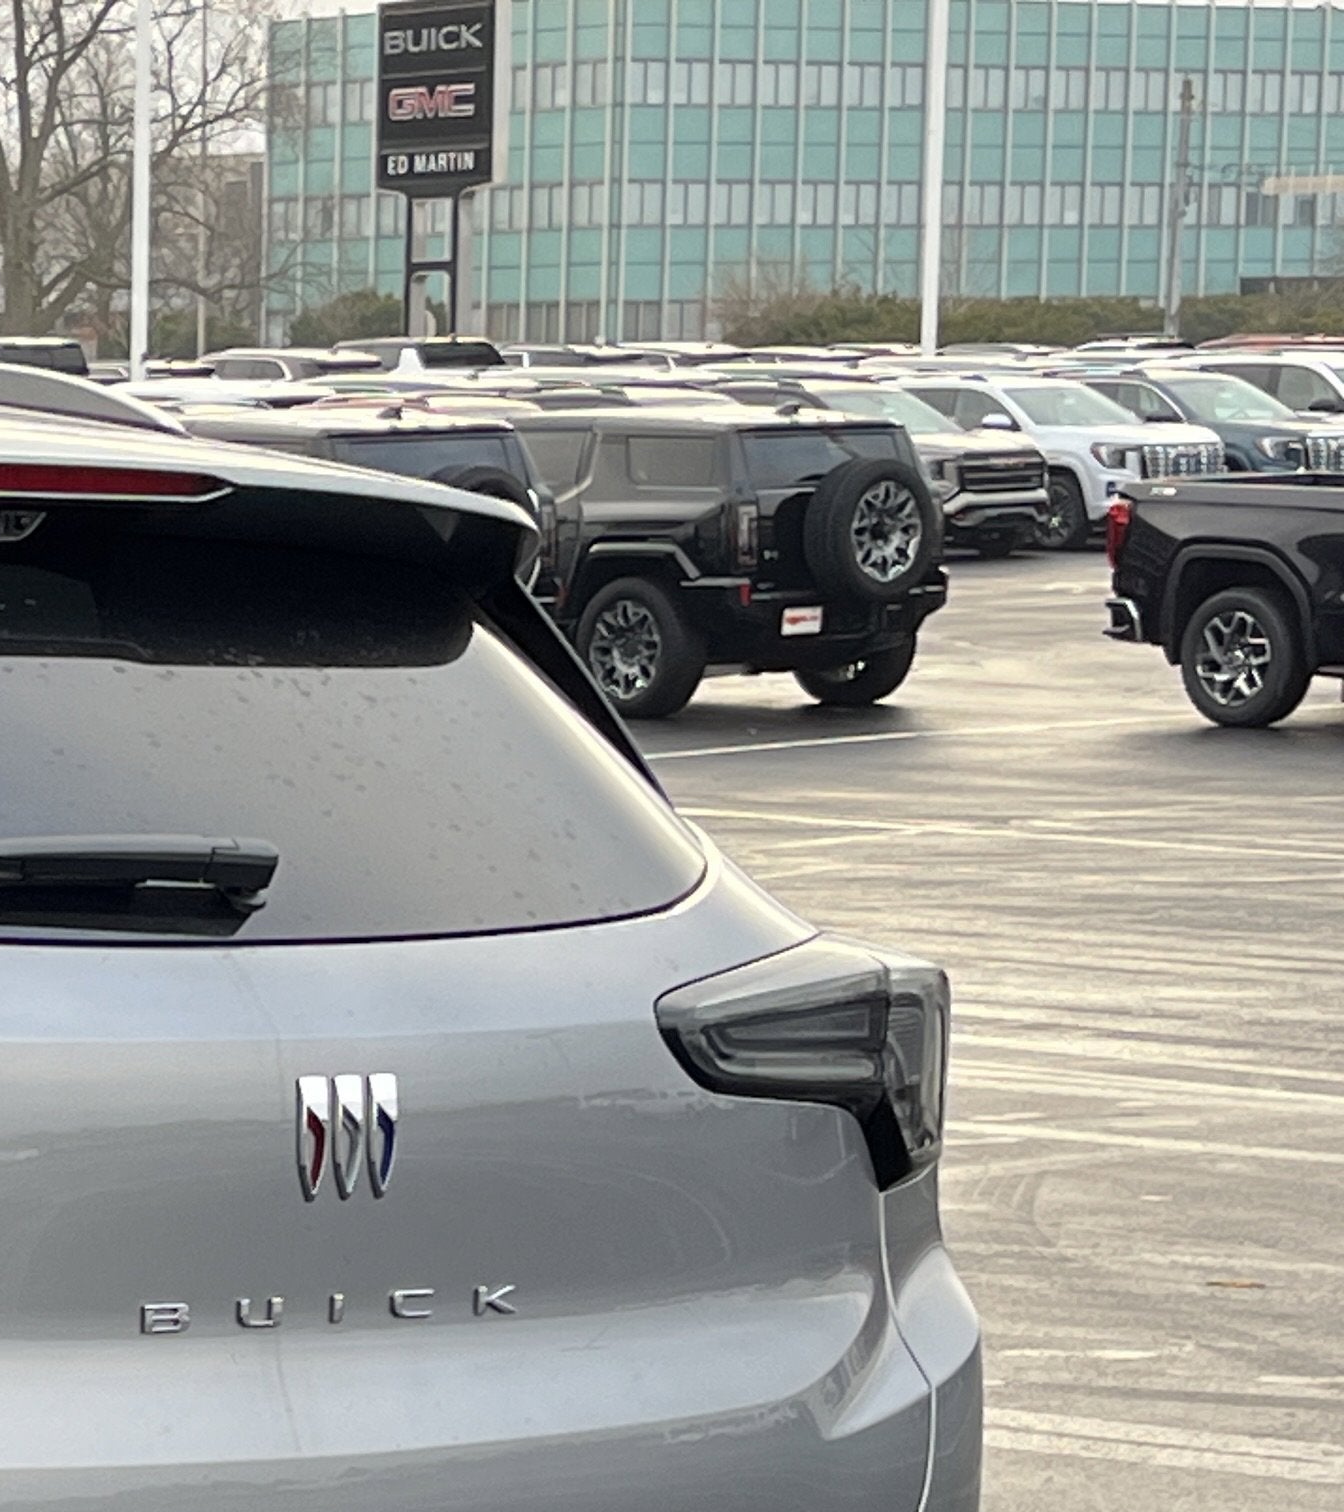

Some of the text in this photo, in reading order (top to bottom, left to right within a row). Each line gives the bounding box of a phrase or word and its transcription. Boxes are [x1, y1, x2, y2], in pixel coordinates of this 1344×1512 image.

[384, 23, 483, 55] BUICK
[388, 82, 475, 121] GMC
[387, 152, 475, 175] ED MARTIN
[140, 1284, 518, 1335] BUICK
